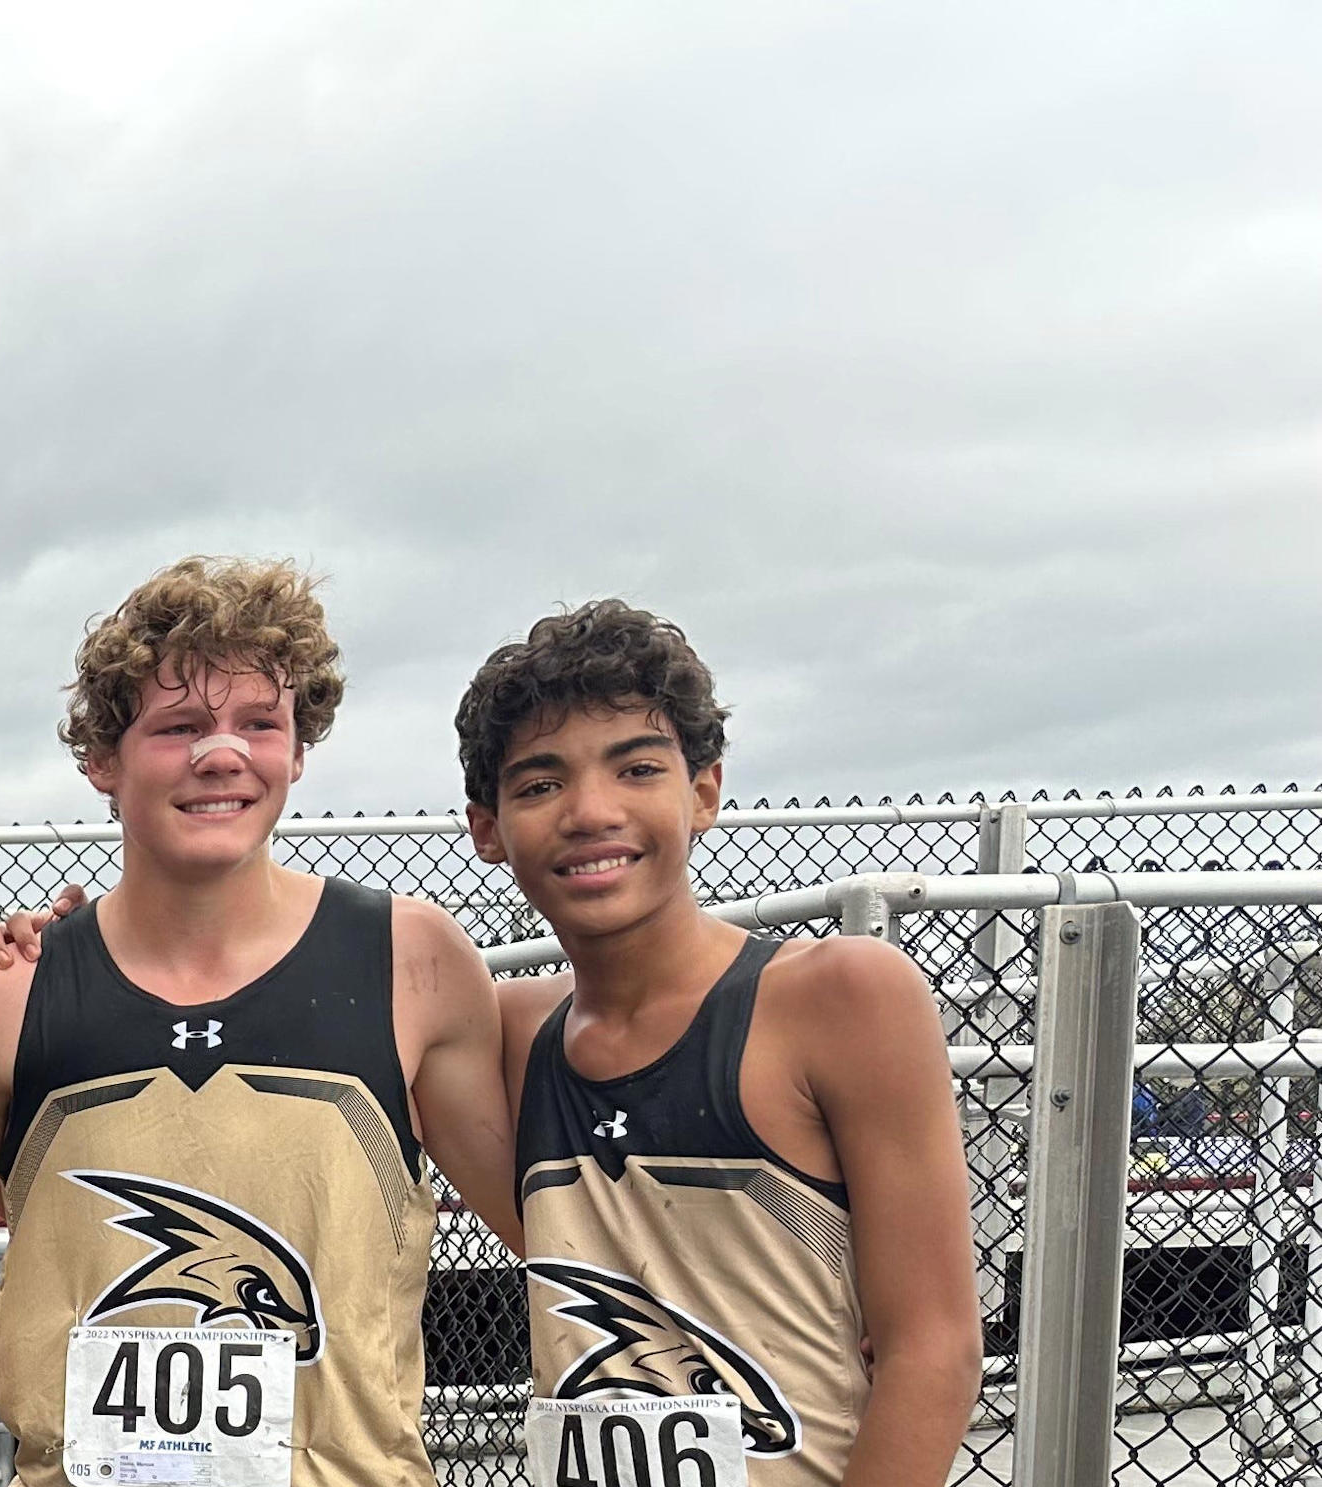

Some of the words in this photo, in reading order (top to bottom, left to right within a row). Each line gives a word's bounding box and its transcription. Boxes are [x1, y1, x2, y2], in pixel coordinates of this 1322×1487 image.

[85, 1330, 110, 1339] 2022
[111, 1330, 172, 1341] NYSPHSAA
[175, 1332, 276, 1342] CHAMPIONSHIPS
[92, 1342, 263, 1437] 405
[554, 1403, 609, 1413] NYSPHSAA
[611, 1399, 721, 1413] CHAMPIONSHIPS
[157, 1441, 213, 1453] ATHLETIC
[69, 1463, 91, 1477] 405
